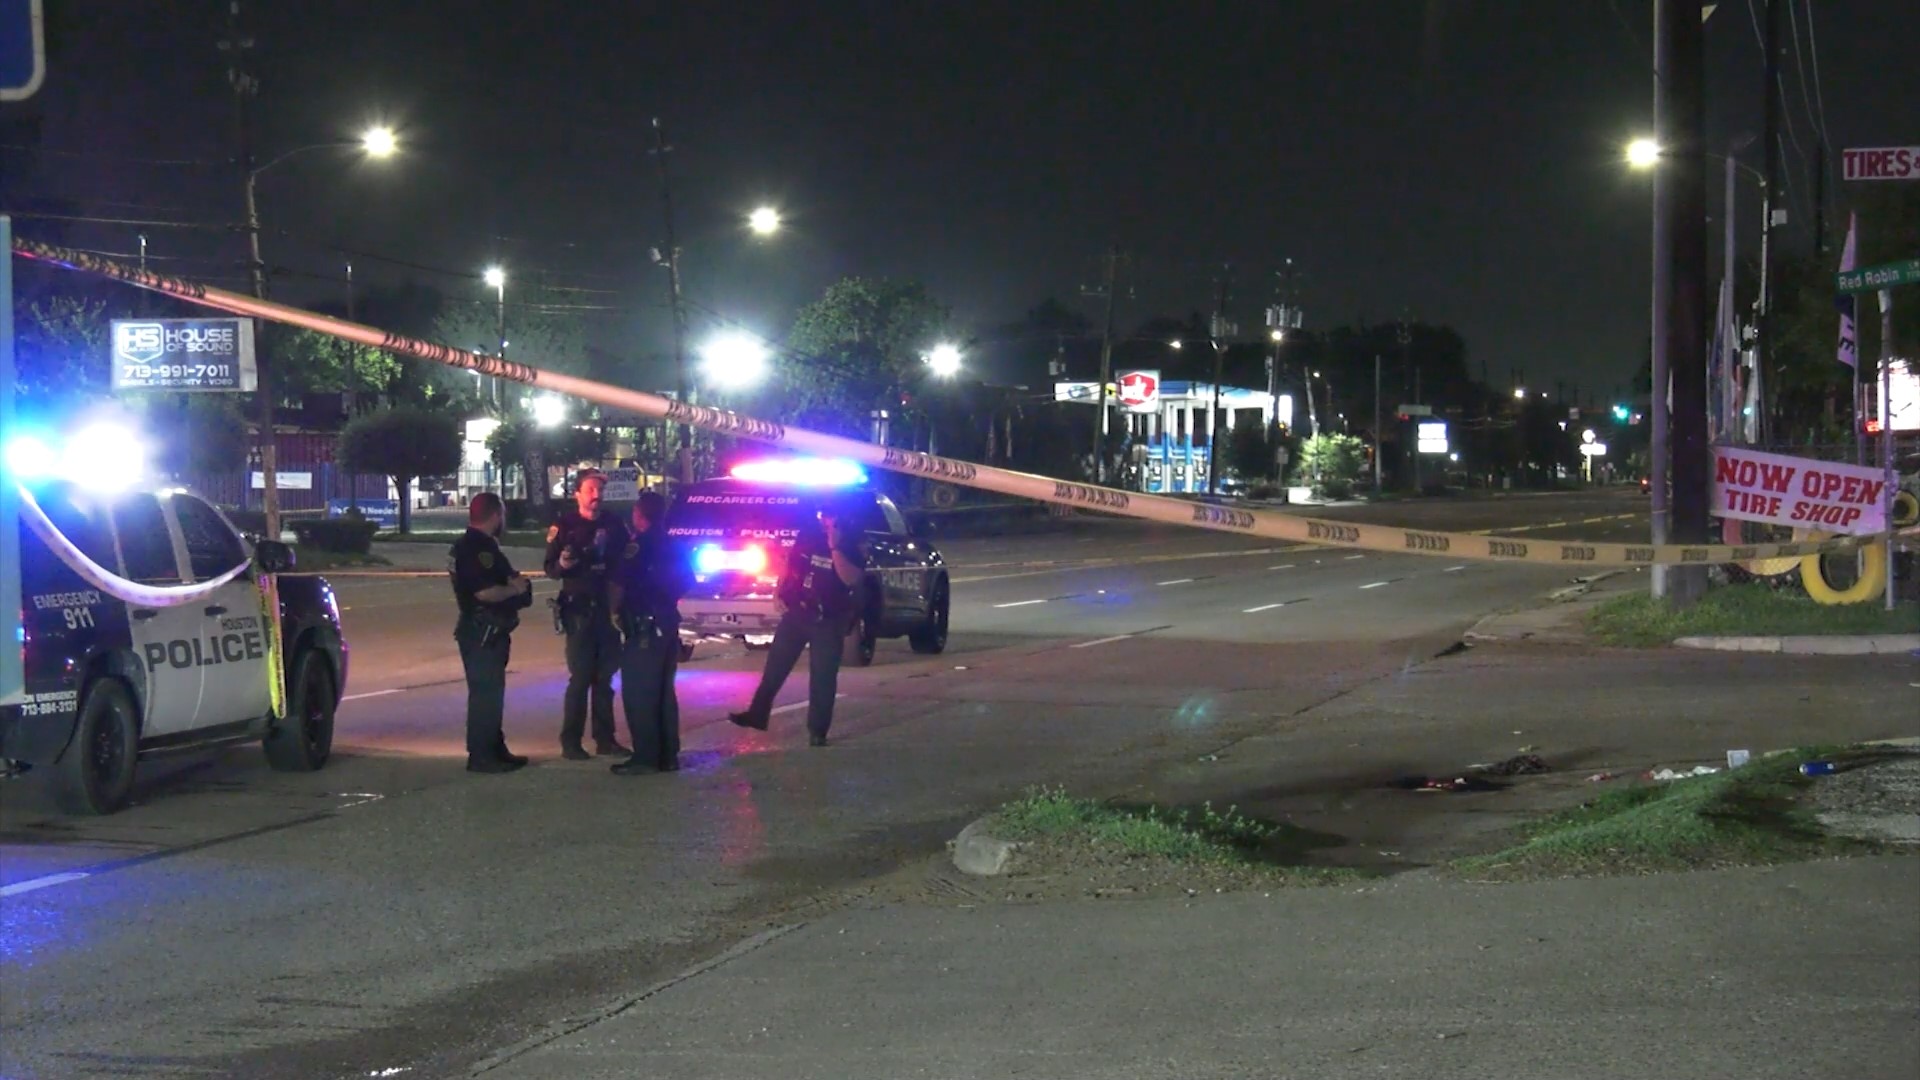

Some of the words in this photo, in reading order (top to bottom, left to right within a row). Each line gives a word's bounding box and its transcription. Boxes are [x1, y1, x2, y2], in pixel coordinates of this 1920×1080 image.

[1843, 149, 1911, 178] TIRES
[1838, 274, 1862, 290] Red
[1865, 268, 1900, 286] Robin
[165, 328, 234, 343] HOUSE
[165, 343, 184, 352] OF
[186, 342, 234, 353] SOUND
[123, 364, 230, 378] 713-991-7011
[1716, 456, 1796, 494] NOW
[1802, 470, 1886, 506] OPEN
[686, 495, 800, 505] HPDCAREER.COM
[1725, 488, 1783, 517] TIRE
[1790, 501, 1862, 527] SHOP
[667, 527, 724, 537] HOUSTON
[740, 528, 801, 539] POLICE
[881, 571, 921, 590] POLICE
[32, 590, 101, 609] EMERGENCY
[63, 606, 95, 630] 911
[221, 616, 259, 630] HOUSTON
[144, 631, 263, 672] POLICE
[36, 690, 78, 703] EMERGENCY
